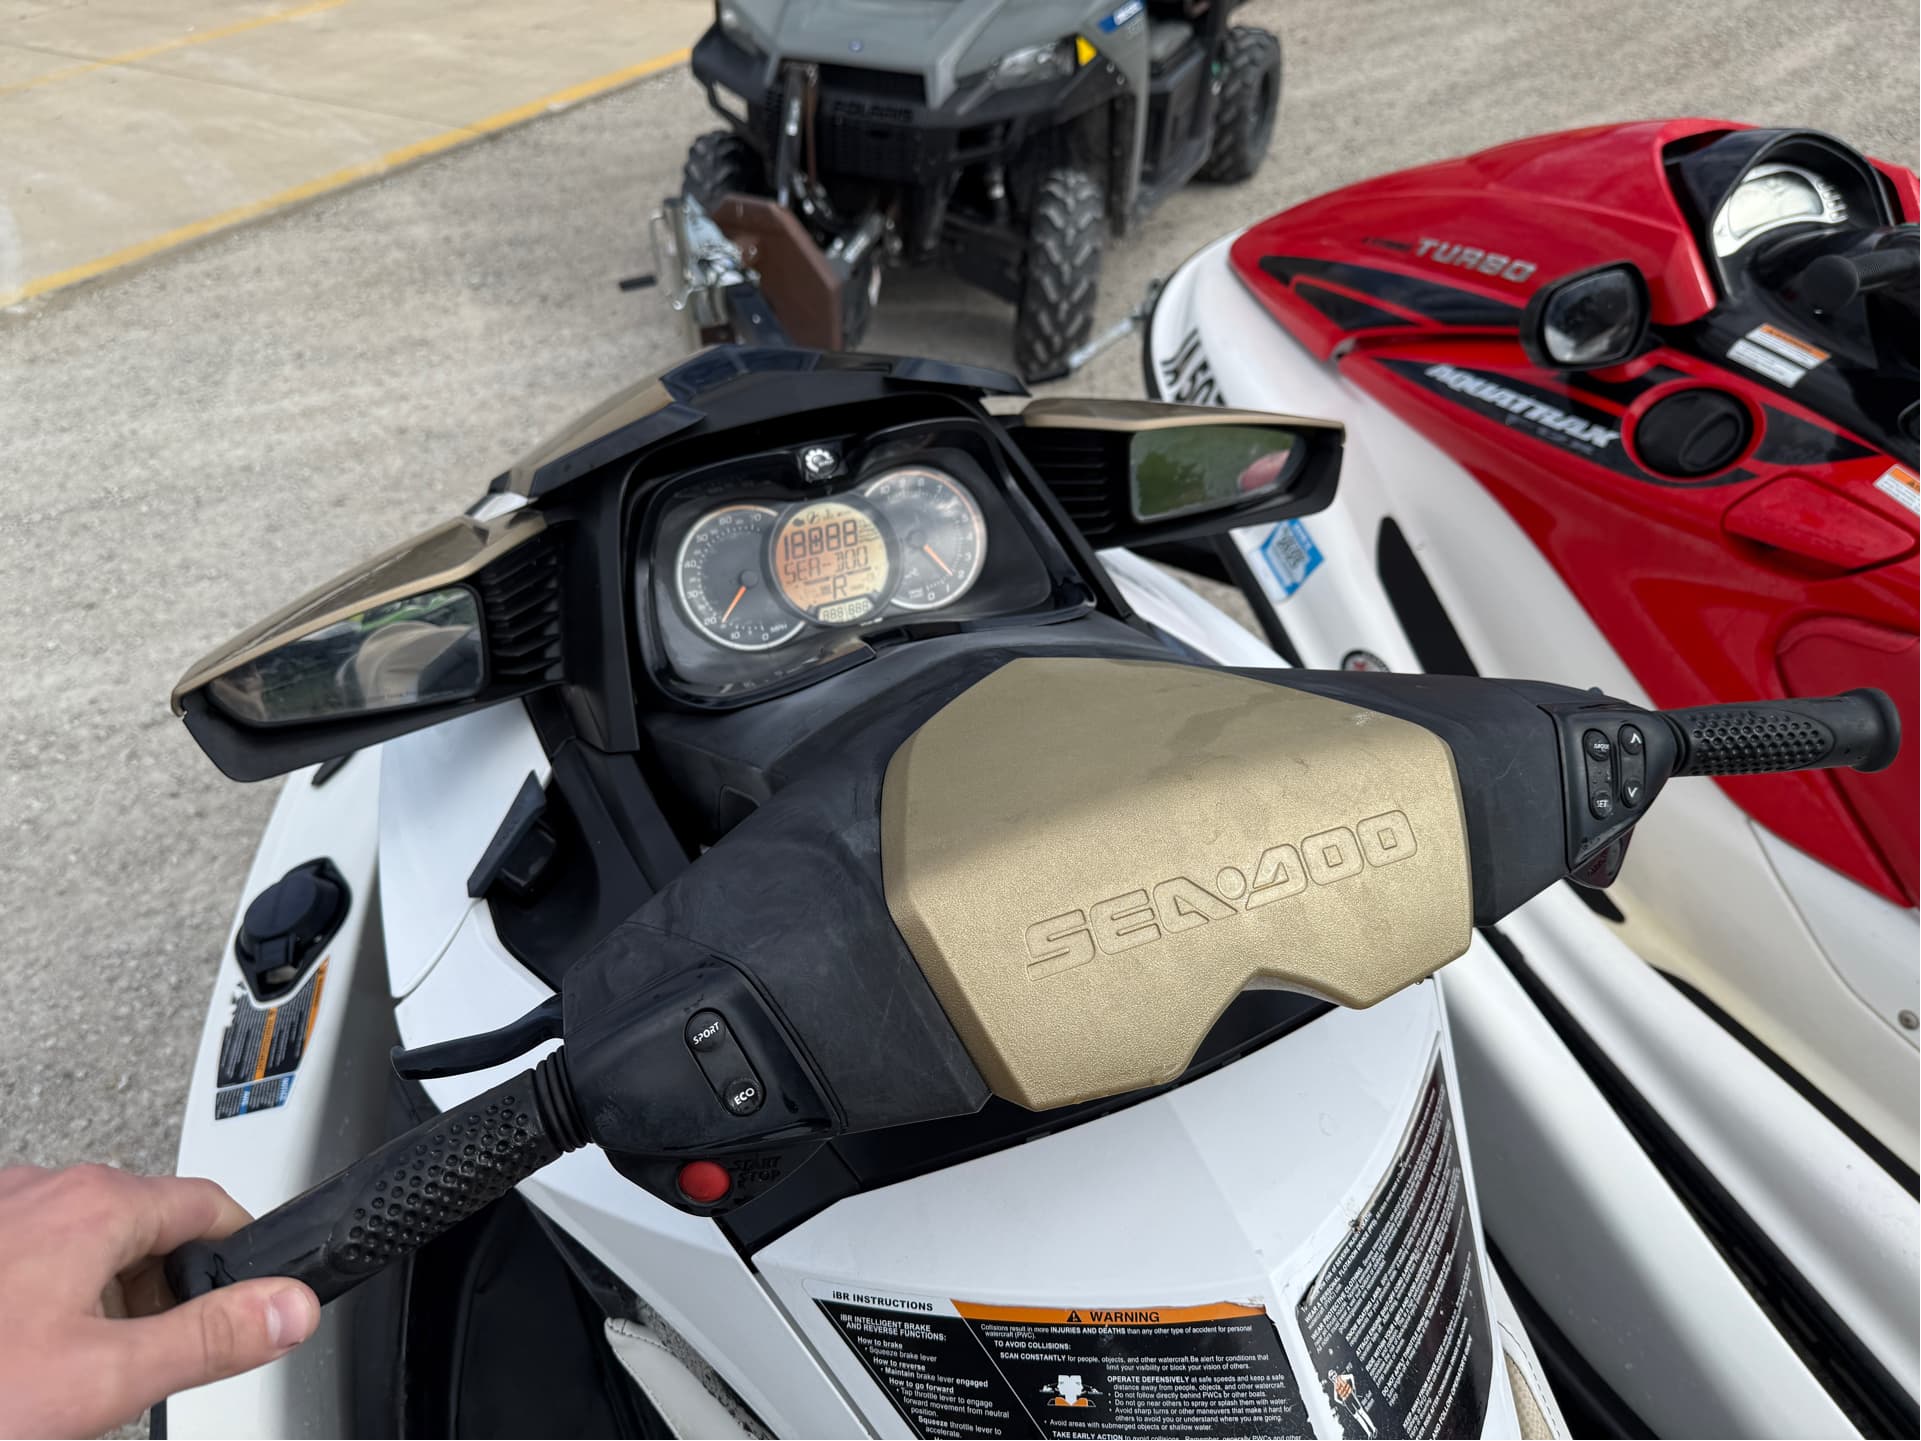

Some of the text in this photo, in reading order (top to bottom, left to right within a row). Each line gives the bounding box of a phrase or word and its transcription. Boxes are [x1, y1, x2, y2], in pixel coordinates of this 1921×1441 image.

[1414, 237, 1538, 283] TURBO
[693, 1022, 720, 1045] SPORT
[734, 1087, 755, 1105] ECO
[833, 1291, 933, 1312] iBR INSTRUCTIONS
[854, 1316, 902, 1328] INTELLIGENT
[904, 1322, 930, 1332] BRAKE
[1090, 1311, 1160, 1323] WARNING
[864, 1324, 898, 1335] REVERSE
[900, 1328, 946, 1341] FUNCTIONS:
[1171, 1327, 1183, 1335] type
[857, 1336, 872, 1344] How
[883, 1339, 902, 1349] brake
[870, 1346, 937, 1362] Squeeze brake lever
[1021, 1353, 1065, 1362] CONSTANTLY
[873, 1357, 888, 1365] How
[899, 1362, 925, 1371] reverse
[1136, 1364, 1160, 1372] visibility
[885, 1367, 988, 1388] Maintain brake lever engaged
[889, 1377, 904, 1386] How
[926, 1384, 954, 1394] forward
[901, 1387, 912, 1396] Tap
[914, 1390, 938, 1400] throttle
[939, 1393, 956, 1402] lever
[966, 1398, 993, 1408] engage
[904, 1397, 1009, 1418] forward movement from neutral
[911, 1407, 938, 1417] position.
[918, 1416, 948, 1427] Squeeze
[950, 1421, 973, 1431] throttle
[975, 1425, 992, 1434] lever
[926, 1427, 962, 1438] accelerate.
